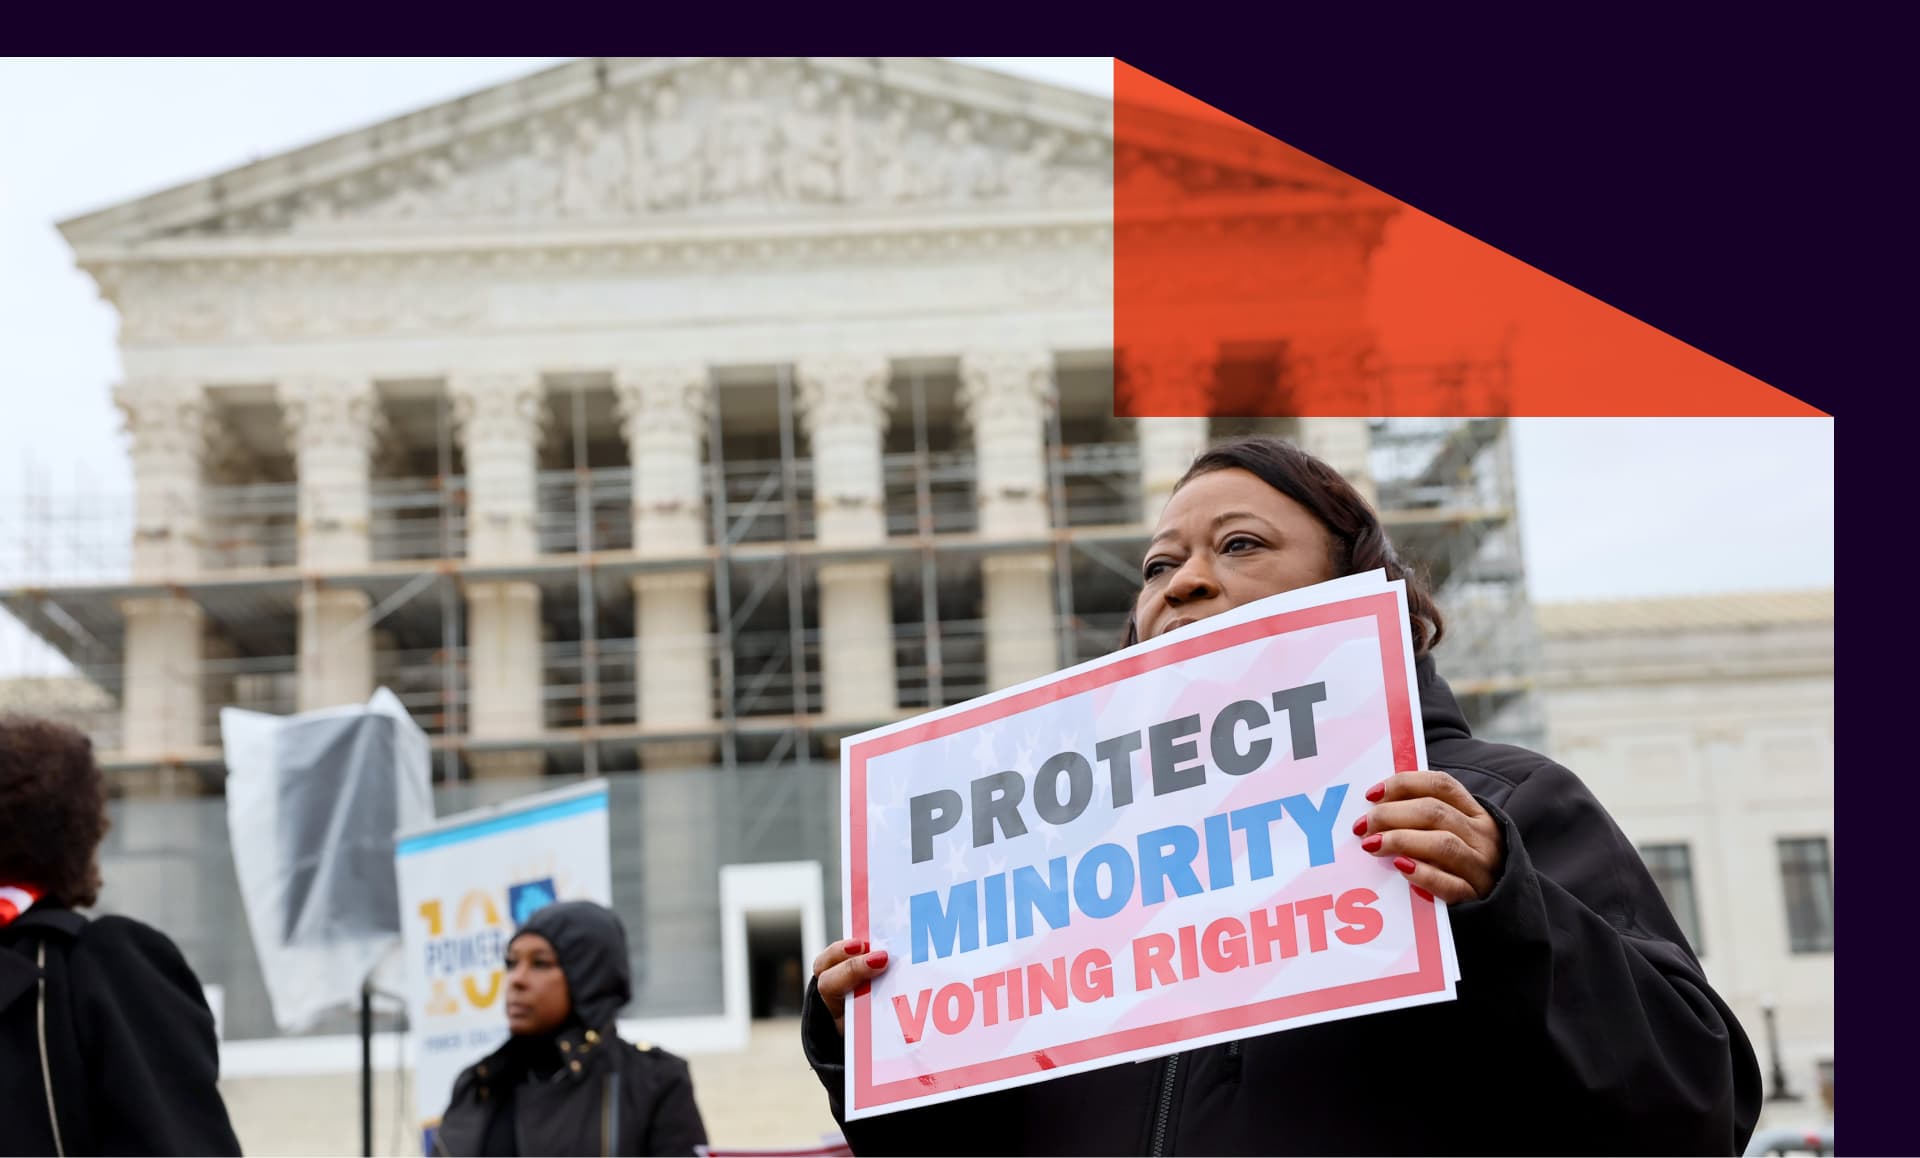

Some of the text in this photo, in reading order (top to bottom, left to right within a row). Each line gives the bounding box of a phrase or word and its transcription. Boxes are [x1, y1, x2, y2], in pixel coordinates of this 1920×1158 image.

[910, 681, 1327, 864] PROTECT
[910, 784, 1349, 965] MINORITY
[892, 888, 1383, 1044] VOTING RIGHTS
